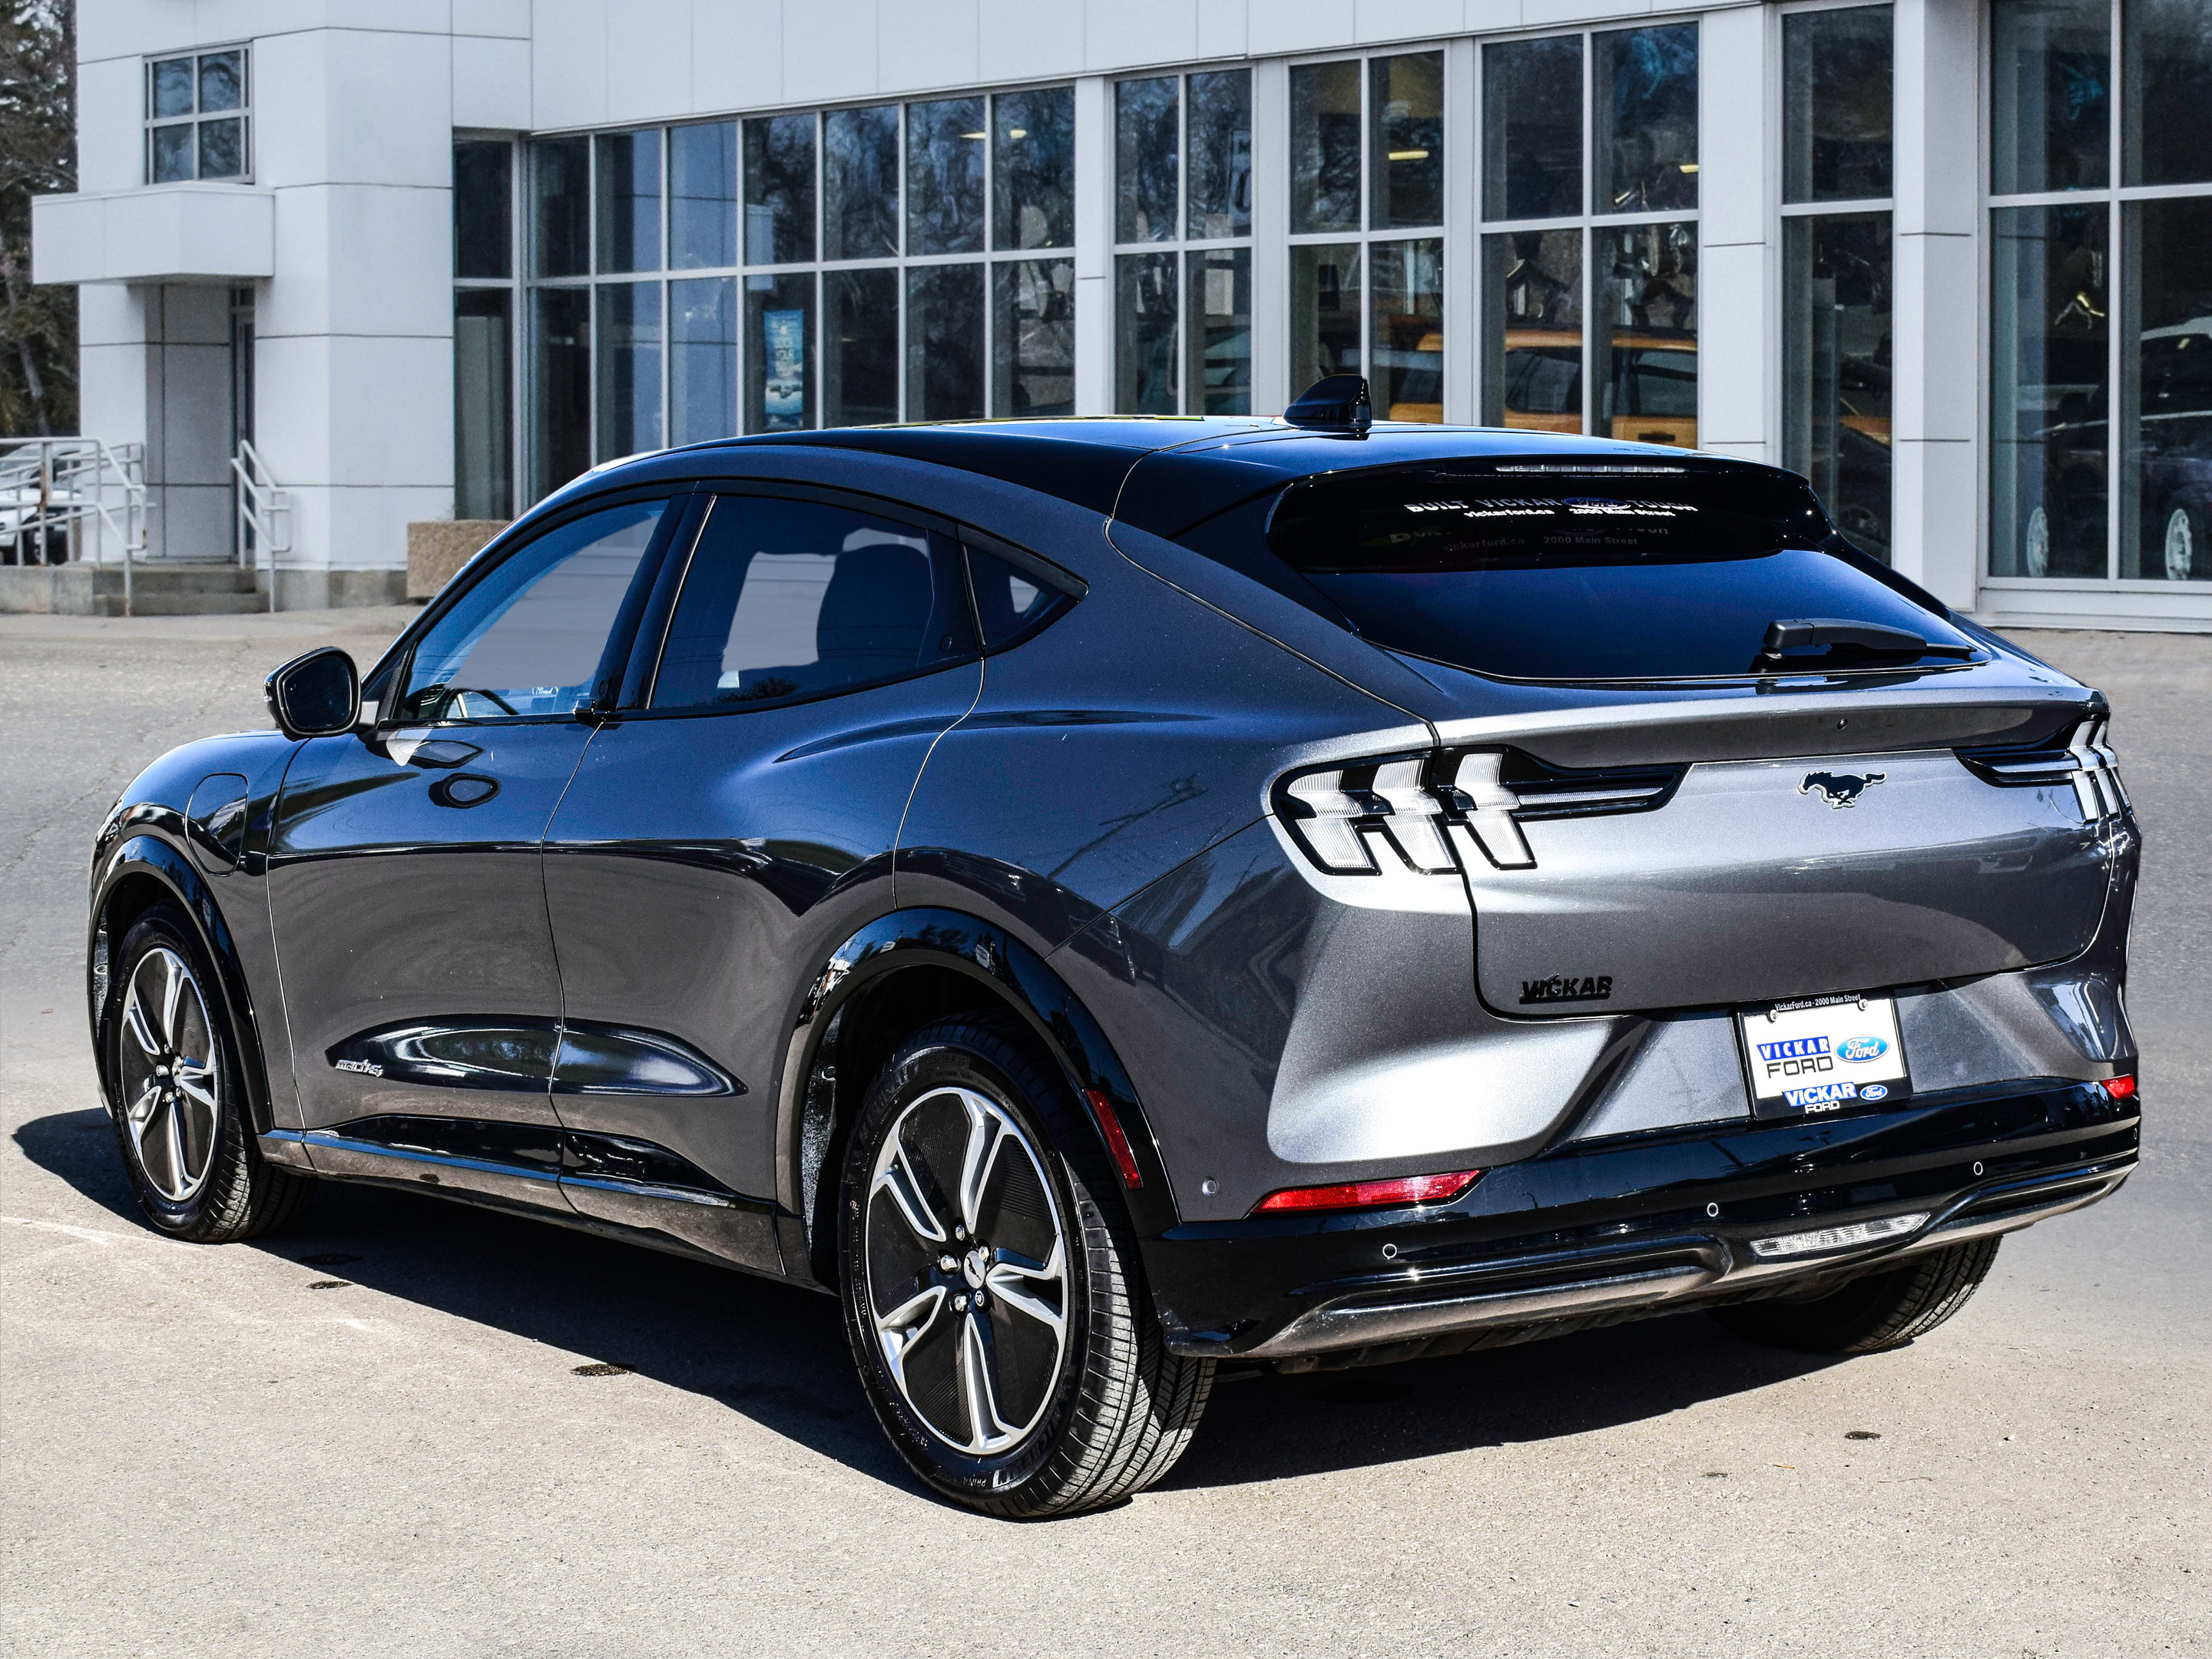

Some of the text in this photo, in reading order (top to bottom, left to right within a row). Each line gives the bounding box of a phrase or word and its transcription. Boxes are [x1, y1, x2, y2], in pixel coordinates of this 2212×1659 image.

[1404, 500, 1469, 512] BUILT
[1474, 498, 1563, 508] VICKAR
[1626, 500, 1698, 512] TOUGH
[1462, 509, 1555, 518] vickarford.ca
[1543, 536, 1572, 545] 2000
[1575, 536, 1601, 545] Main
[1604, 537, 1639, 545] Street
[1521, 973, 1613, 998] VICKAR
[1775, 993, 1861, 1012] VickarFord.ca 2000 Main Street
[1760, 1038, 1830, 1059] VICKAR
[1767, 1055, 1833, 1078] FORD
[1785, 1082, 1857, 1106] VICKAR
[1805, 1100, 1840, 1114] FORD
